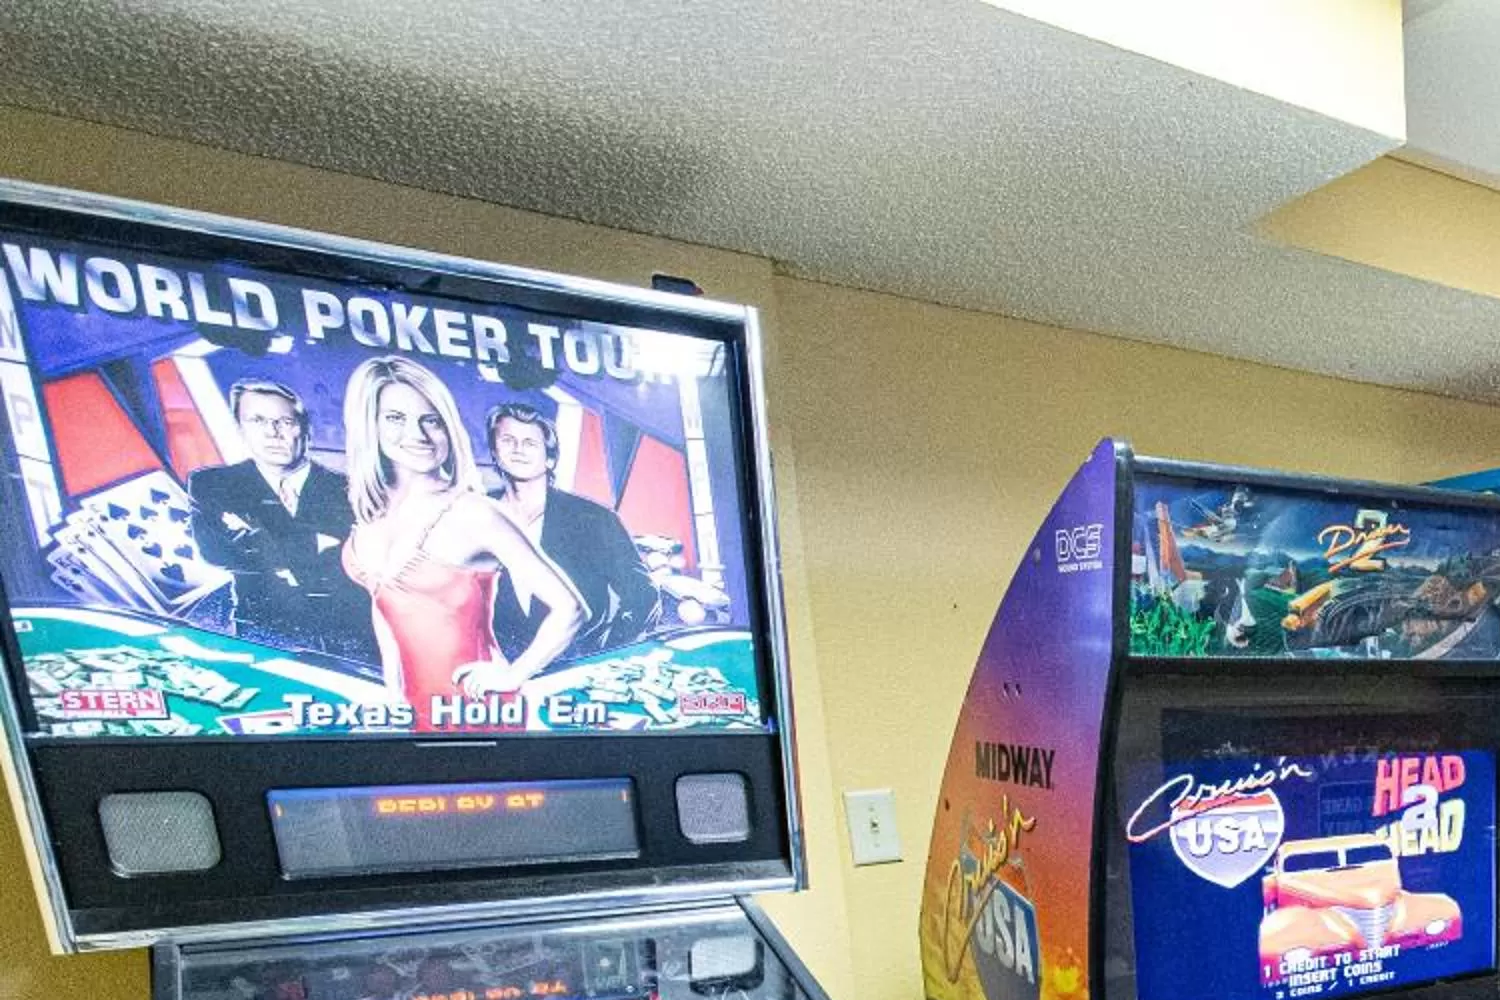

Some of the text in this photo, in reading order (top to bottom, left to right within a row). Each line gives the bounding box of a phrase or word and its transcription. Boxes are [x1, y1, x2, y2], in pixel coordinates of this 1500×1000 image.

[3, 243, 674, 386] WORLD POKER TOU
[1056, 523, 1104, 562] DCS
[63, 689, 158, 712] STERN
[283, 693, 413, 727] Texas
[431, 694, 526, 726] Hold
[975, 740, 1056, 788] MIDWAY
[1373, 754, 1466, 817] HEAD
[1185, 815, 1268, 857] USA
[975, 886, 1036, 985] USA
[1279, 956, 1327, 975] CREDIT
[1334, 951, 1351, 965] TO
[1359, 944, 1400, 962] START
[1289, 968, 1338, 988] INSERT
[1344, 961, 1383, 979] COINS
